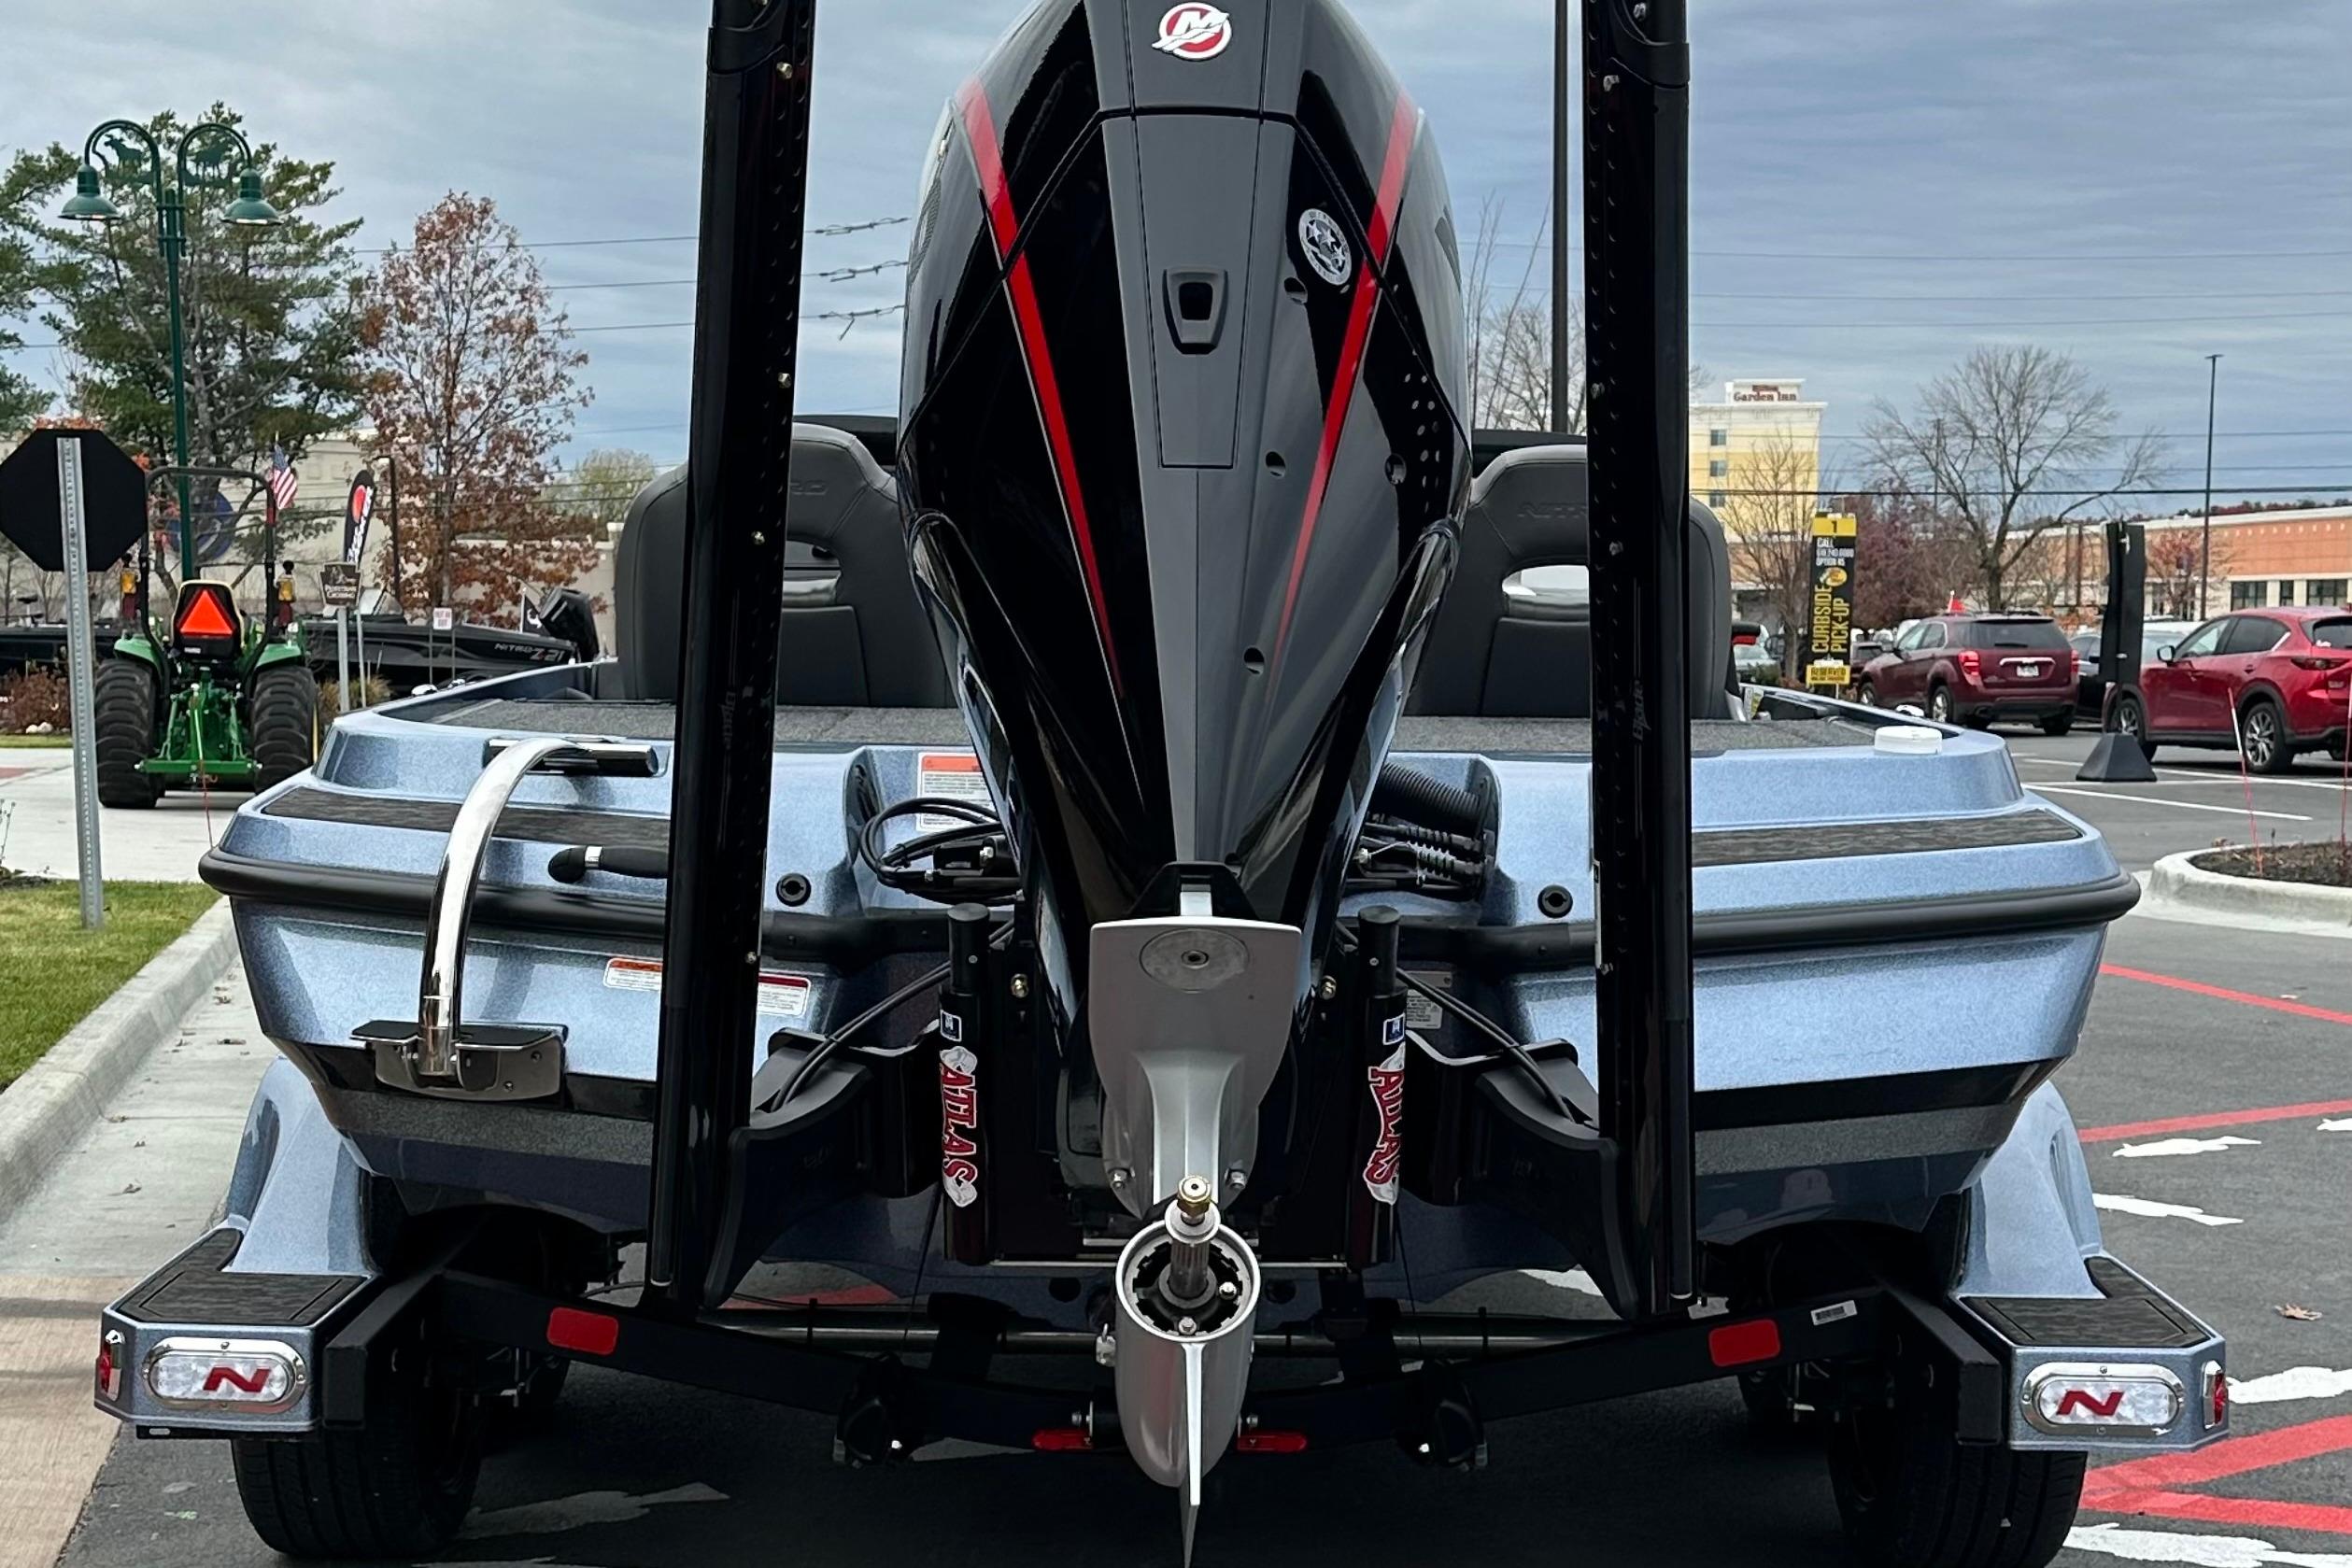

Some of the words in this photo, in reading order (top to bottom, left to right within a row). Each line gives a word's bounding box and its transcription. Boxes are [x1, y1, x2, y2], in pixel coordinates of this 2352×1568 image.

[1734, 391, 1775, 402] Garden
[1778, 391, 1797, 402] Inn
[1831, 520, 1837, 533] 1
[1812, 585, 1832, 653] CURBSIDE
[1831, 598, 1849, 653] PICK-UP
[494, 643, 532, 653] NITRO
[940, 1062, 978, 1184] ATLAS
[203, 1366, 271, 1393] N
[2056, 1390, 2125, 1417] N
